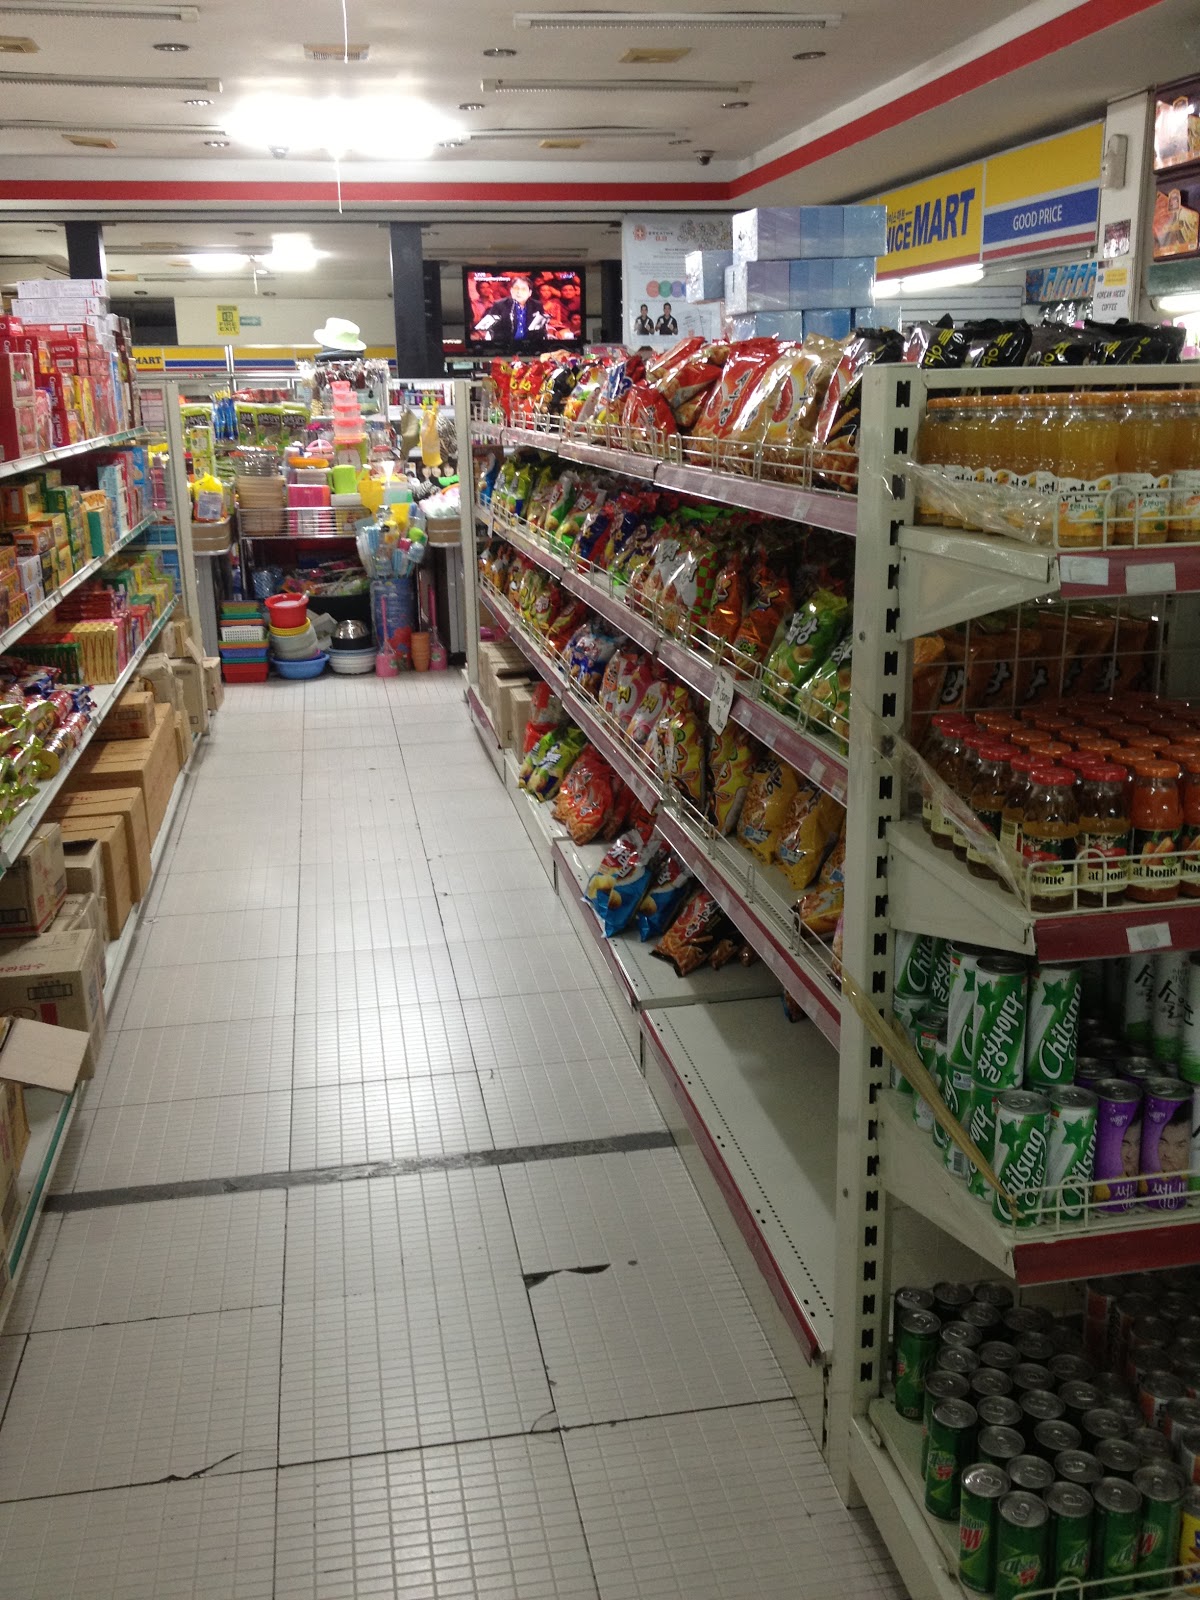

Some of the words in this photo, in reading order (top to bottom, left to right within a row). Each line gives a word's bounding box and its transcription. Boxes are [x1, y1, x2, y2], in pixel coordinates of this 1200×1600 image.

[1012, 213, 1037, 231] GOOD
[1038, 204, 1063, 224] PRICE
[1101, 302, 1118, 312] COFFEE
[1088, 871, 1099, 881] at
[1133, 866, 1143, 877] at
[1145, 866, 1178, 878] home
[977, 991, 1024, 1084] 칠성사이다
[1024, 1152, 1045, 1207] Cider
